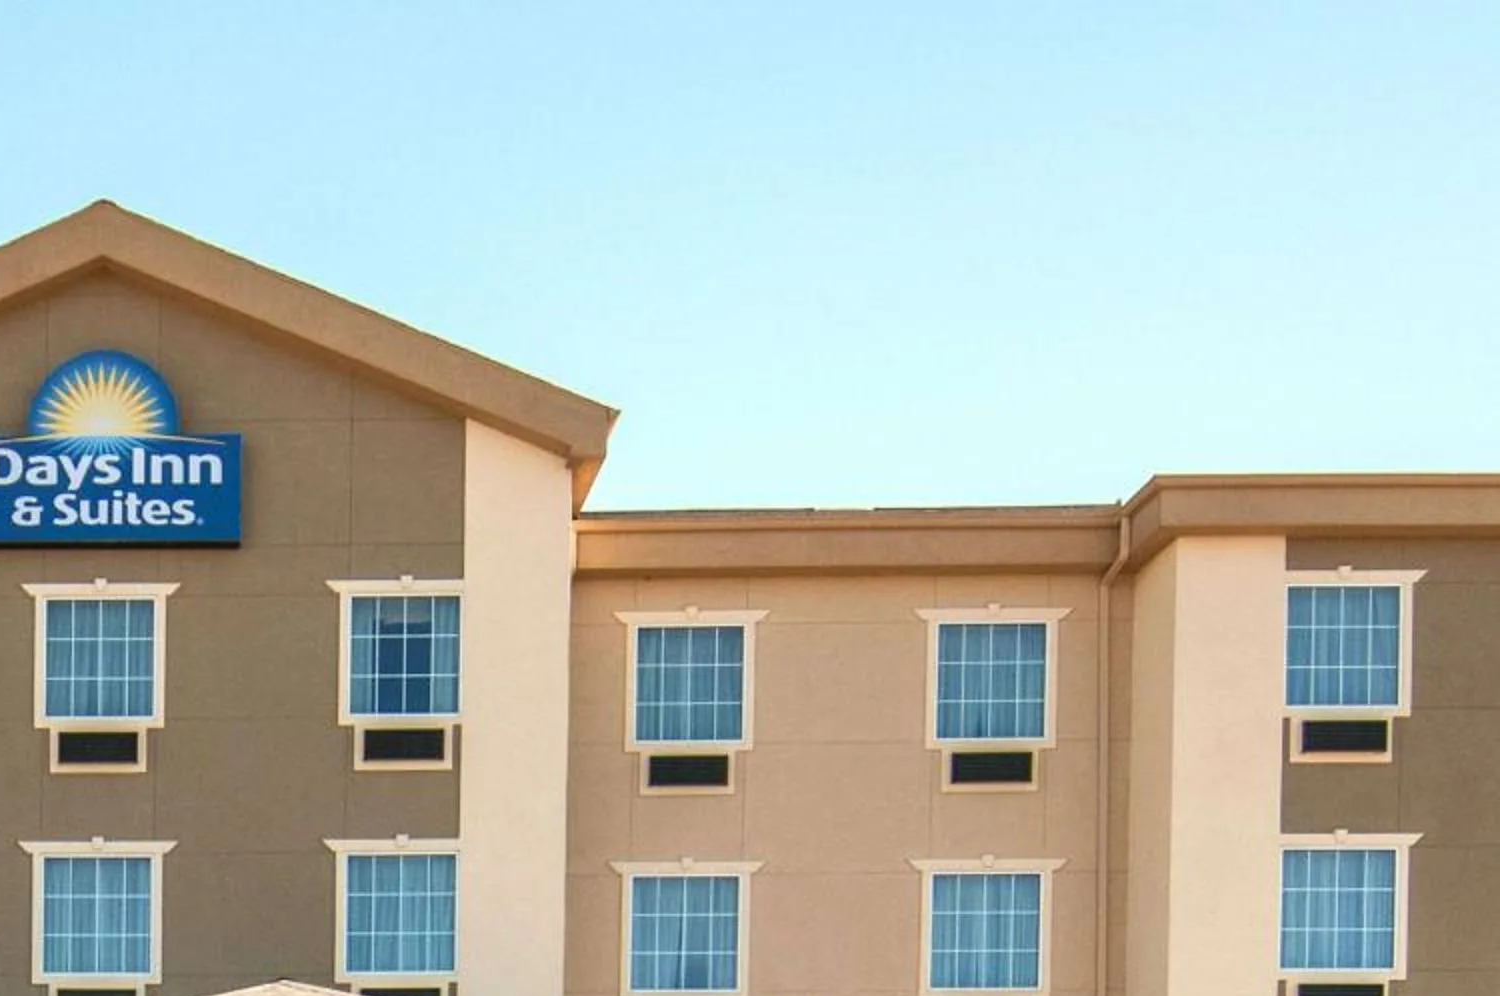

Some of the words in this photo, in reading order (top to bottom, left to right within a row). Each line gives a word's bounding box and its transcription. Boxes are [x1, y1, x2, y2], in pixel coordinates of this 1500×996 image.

[132, 447, 223, 485] Inn
[11, 496, 44, 526] &
[53, 490, 196, 526] Suites
